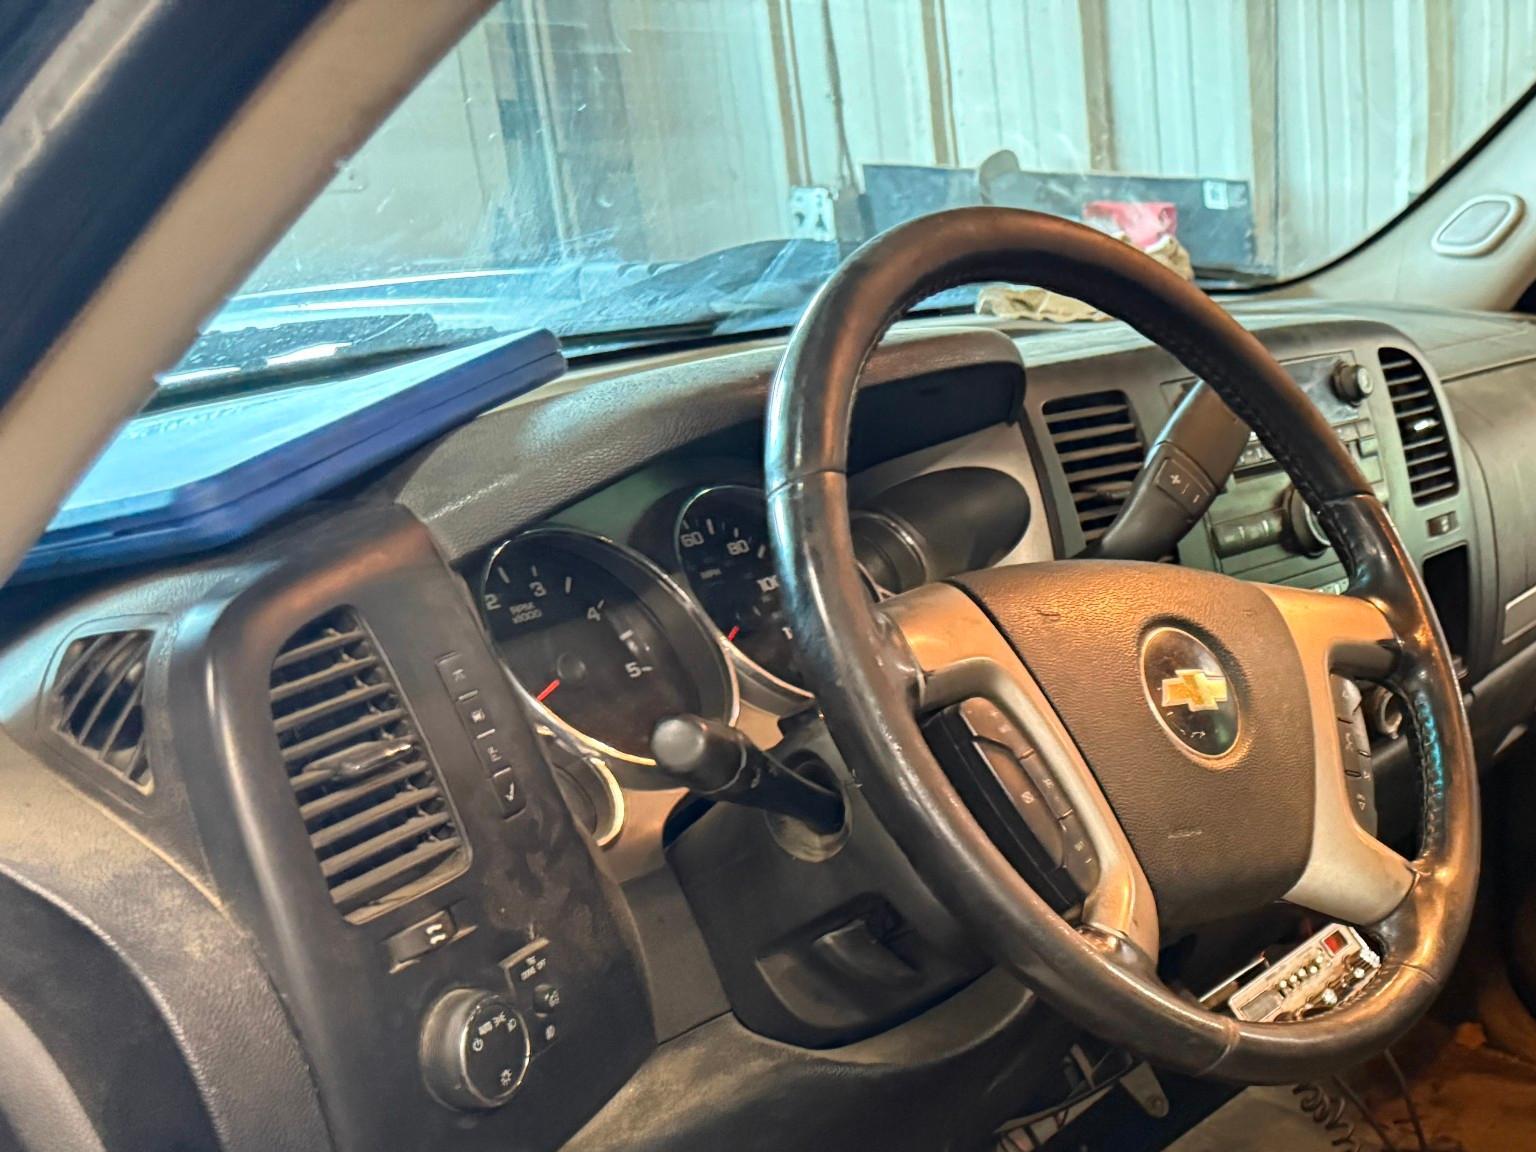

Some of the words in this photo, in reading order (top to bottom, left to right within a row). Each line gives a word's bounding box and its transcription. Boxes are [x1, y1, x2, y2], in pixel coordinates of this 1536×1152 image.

[680, 531, 704, 547] 60
[726, 540, 750, 555] 80
[529, 581, 547, 597] 3
[484, 594, 501, 610] 2
[586, 606, 601, 621] 4
[625, 662, 642, 678] 5
